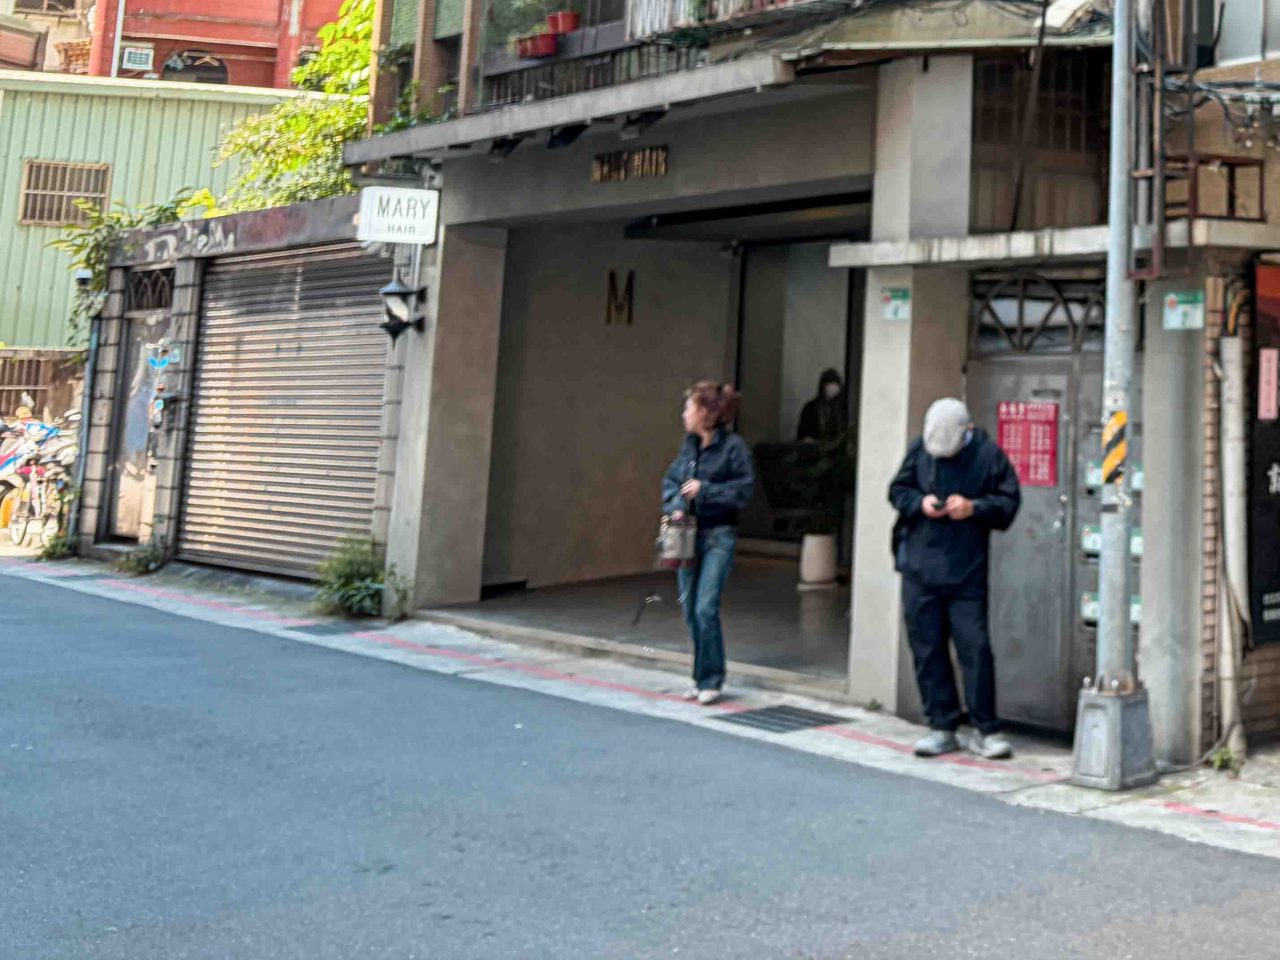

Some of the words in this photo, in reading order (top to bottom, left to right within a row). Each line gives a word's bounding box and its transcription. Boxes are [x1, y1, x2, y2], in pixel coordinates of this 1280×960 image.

[377, 195, 431, 219] MARY
[387, 224, 416, 235] HAIR
[606, 268, 635, 326] M
